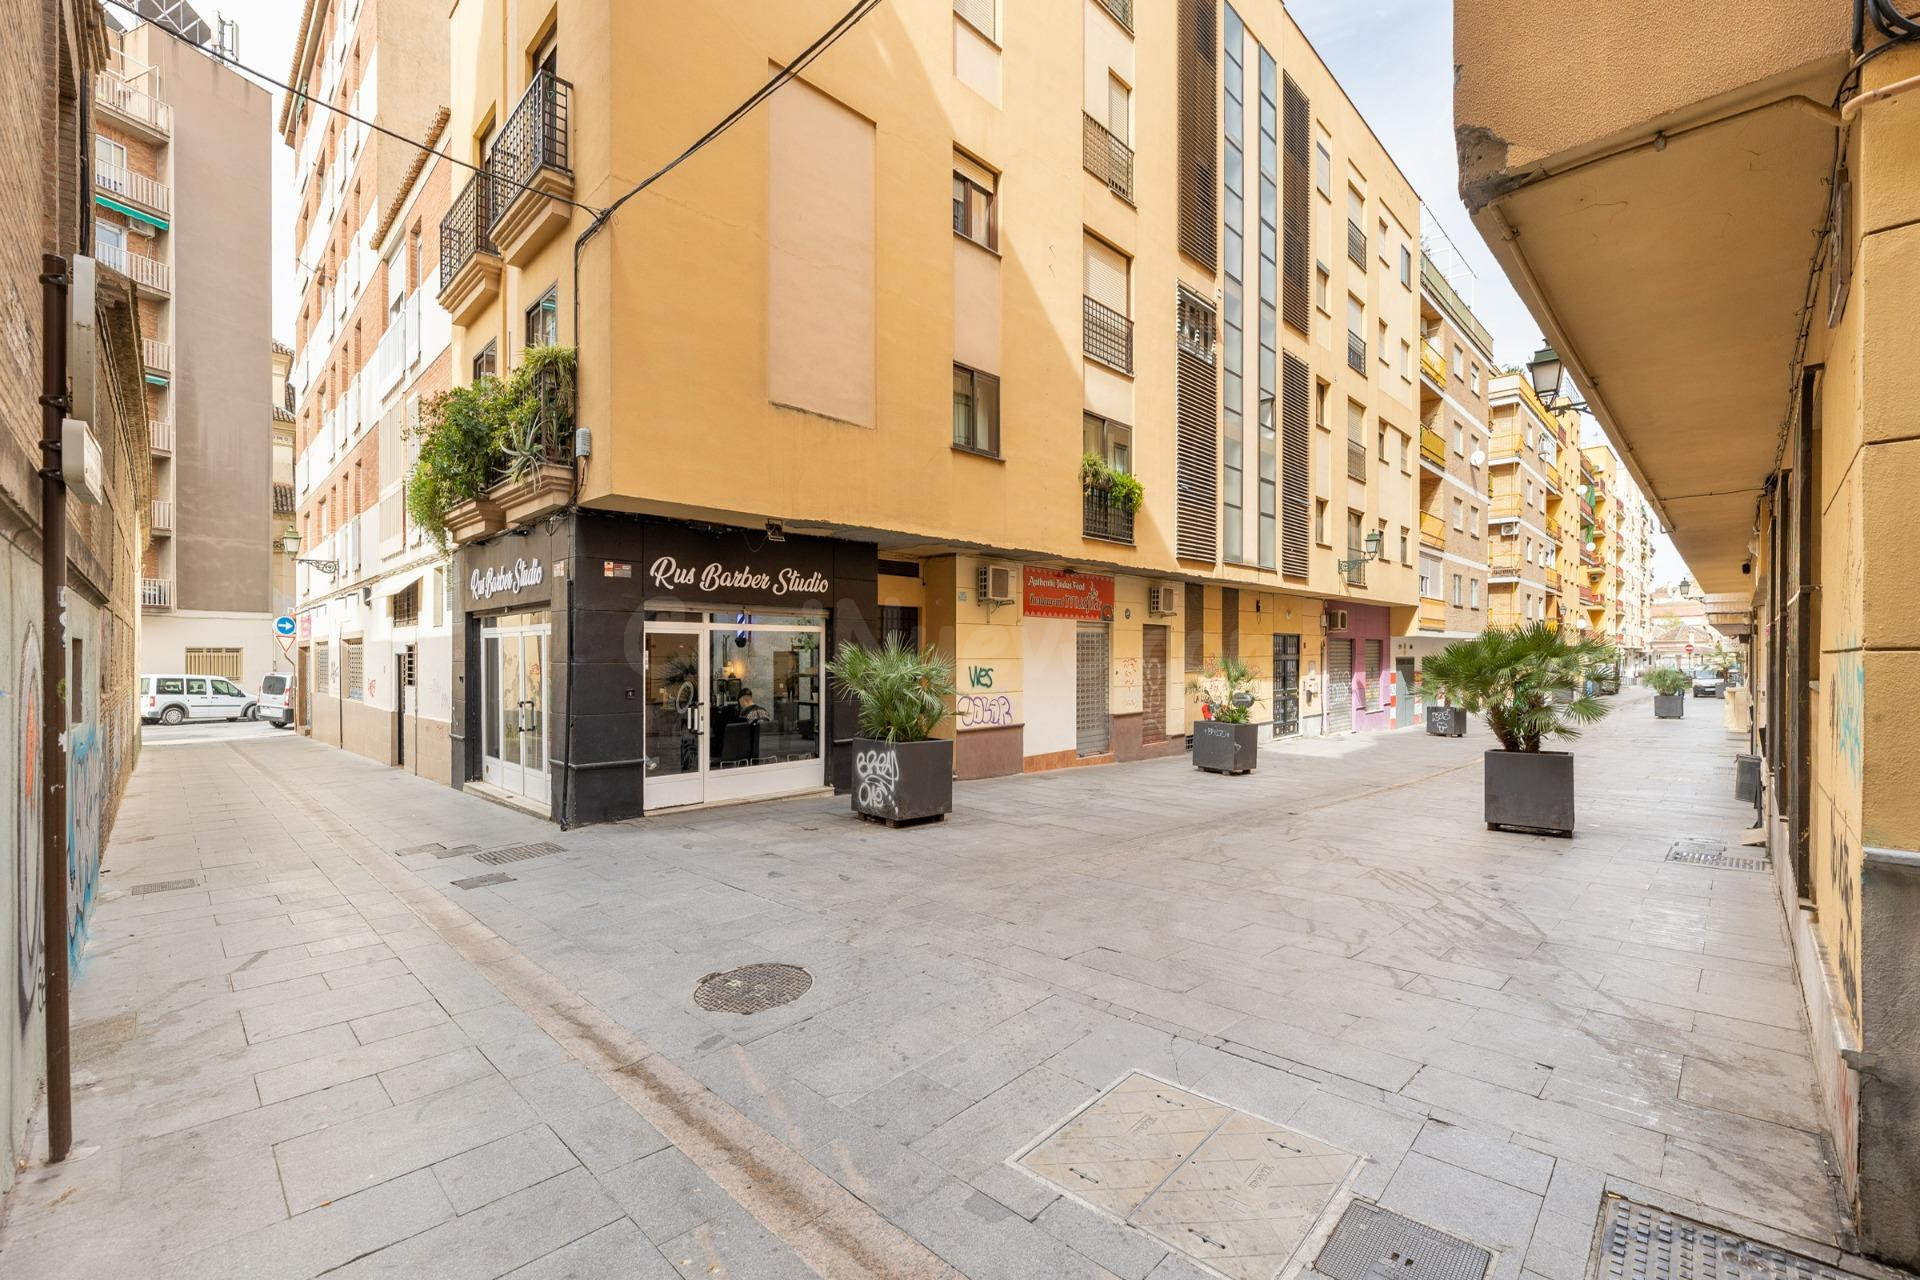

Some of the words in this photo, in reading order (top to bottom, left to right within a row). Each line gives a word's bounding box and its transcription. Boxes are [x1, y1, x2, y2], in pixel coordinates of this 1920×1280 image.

[471, 568, 486, 600] Rus
[485, 565, 513, 599] Barber
[512, 557, 543, 594] Studio
[649, 556, 696, 590] Rus
[699, 562, 770, 592] Barber
[772, 567, 829, 596] Studio
